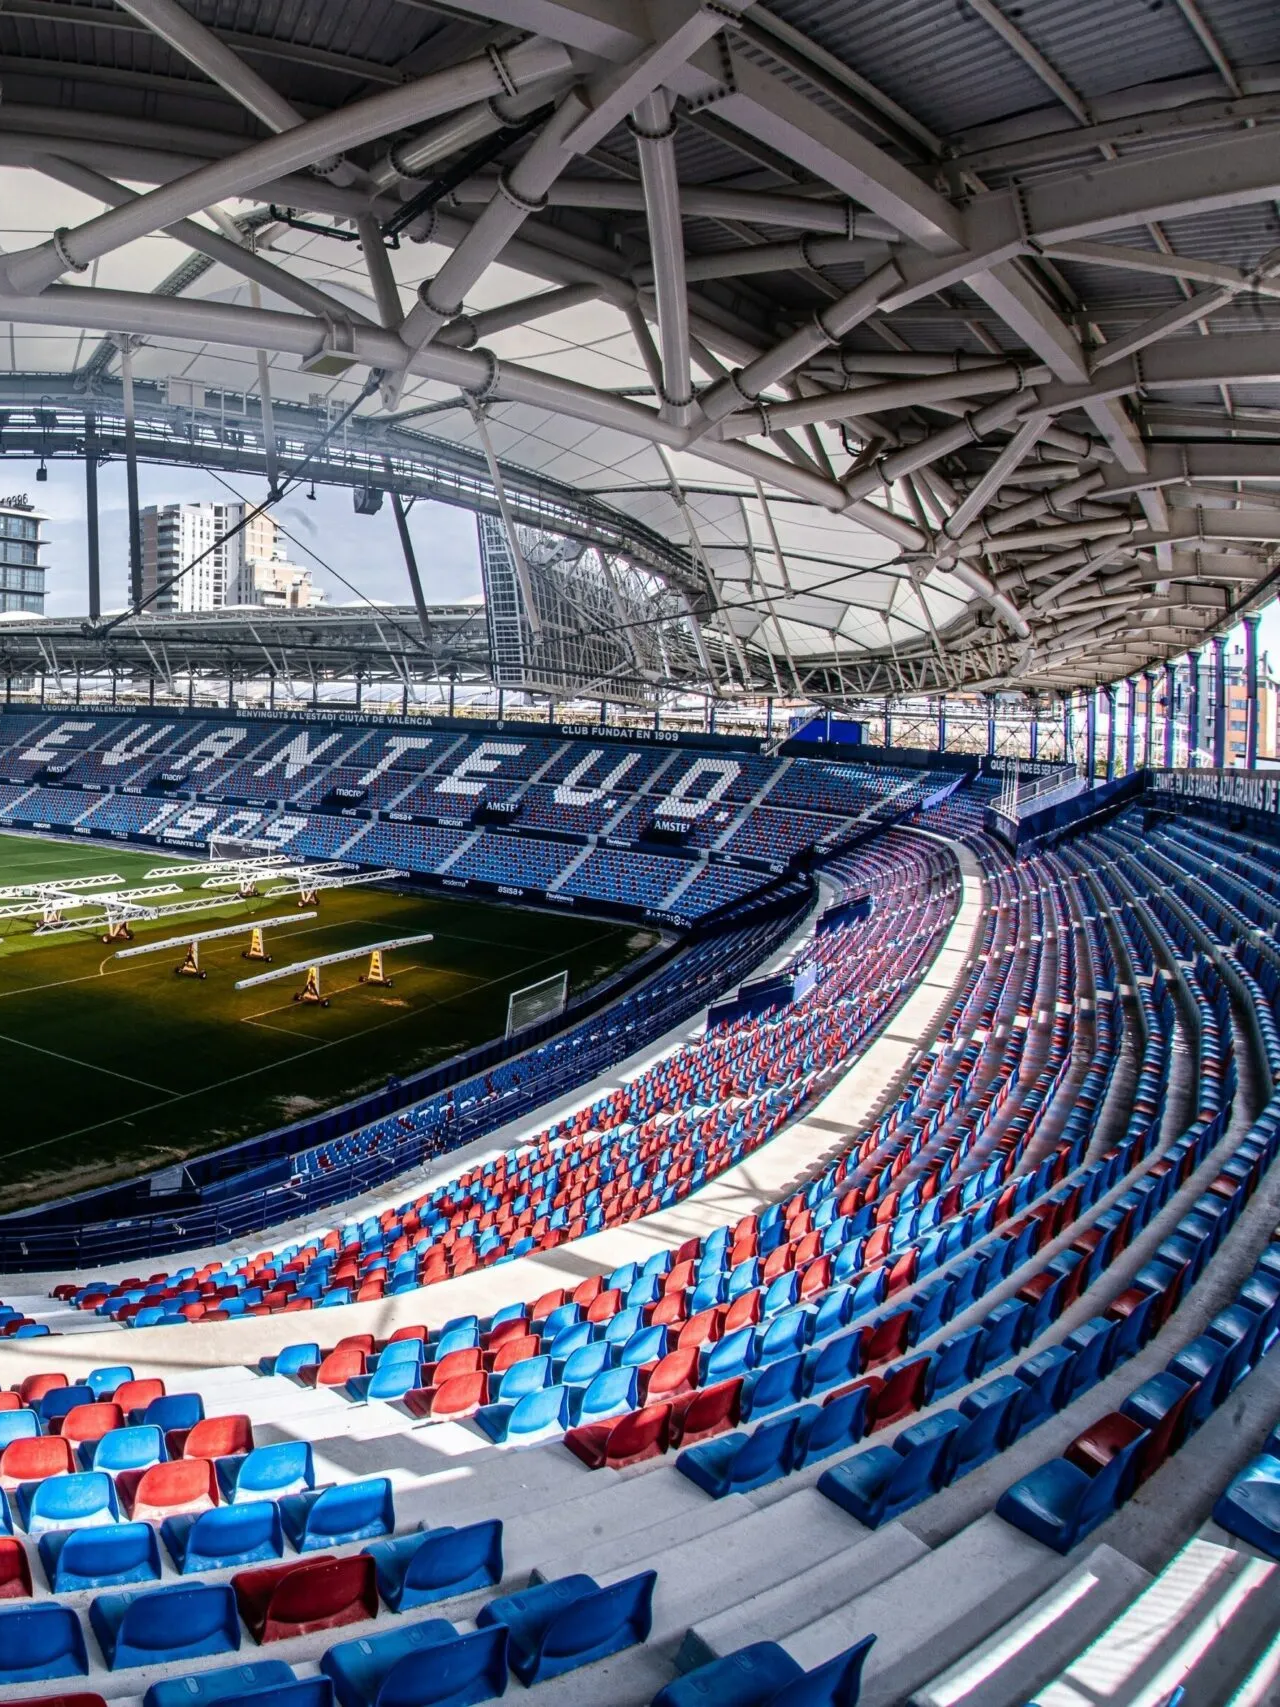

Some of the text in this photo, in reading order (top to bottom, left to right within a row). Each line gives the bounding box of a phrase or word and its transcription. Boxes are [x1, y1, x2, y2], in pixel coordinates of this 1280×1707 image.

[90, 705, 137, 713] VALENCIANS
[236, 709, 289, 719] BENVINGUTS
[290, 712, 297, 720] A
[299, 712, 336, 720] L'ESTADI
[339, 714, 370, 723] CIUTAT
[372, 715, 385, 724] DE
[561, 725, 679, 741] CLUB FUNDAT EN 1909
[138, 803, 308, 850] 1909
[438, 818, 463, 827] macron
[164, 838, 194, 847] LEVANTE
